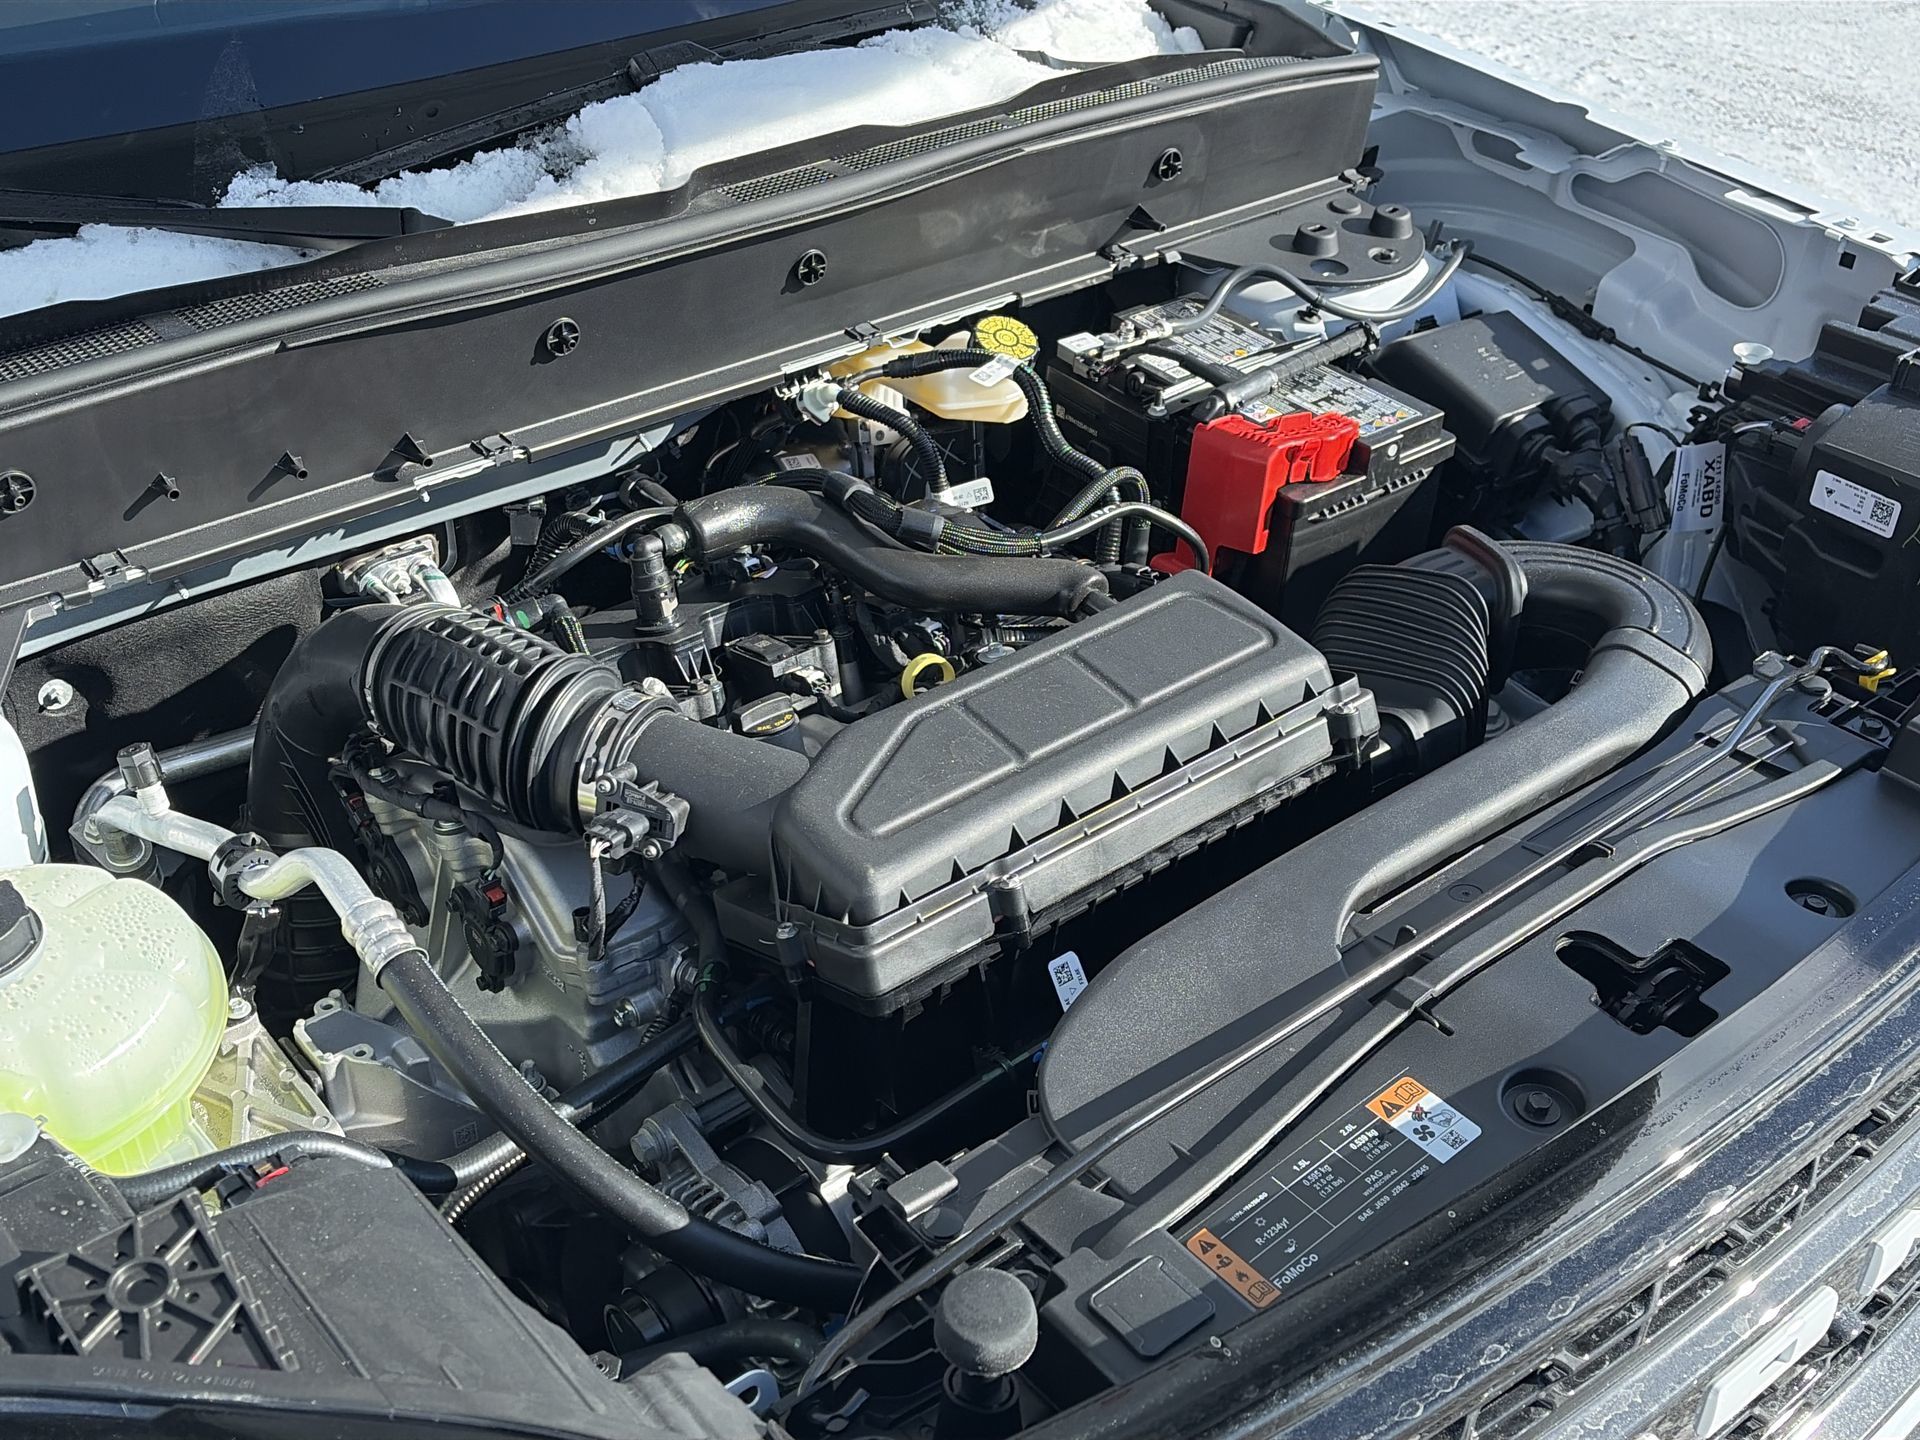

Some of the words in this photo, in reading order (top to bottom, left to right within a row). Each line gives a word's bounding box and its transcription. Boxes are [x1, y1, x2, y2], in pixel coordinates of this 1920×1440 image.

[1677, 473, 1689, 511] FoMoCo
[1700, 459, 1715, 517] XABD
[1339, 1122, 1358, 1137] 2.0L
[1365, 1127, 1379, 1139] kg
[1292, 1159, 1311, 1173] 1.5L
[1319, 1163, 1332, 1174] kg
[1365, 1169, 1383, 1185] PAG
[1358, 1207, 1374, 1222] SAE
[1374, 1195, 1391, 1210] J639
[1390, 1180, 1410, 1196] J2842
[1255, 1217, 1290, 1246] R-1234yf
[1273, 1251, 1319, 1289] FoMoCo
